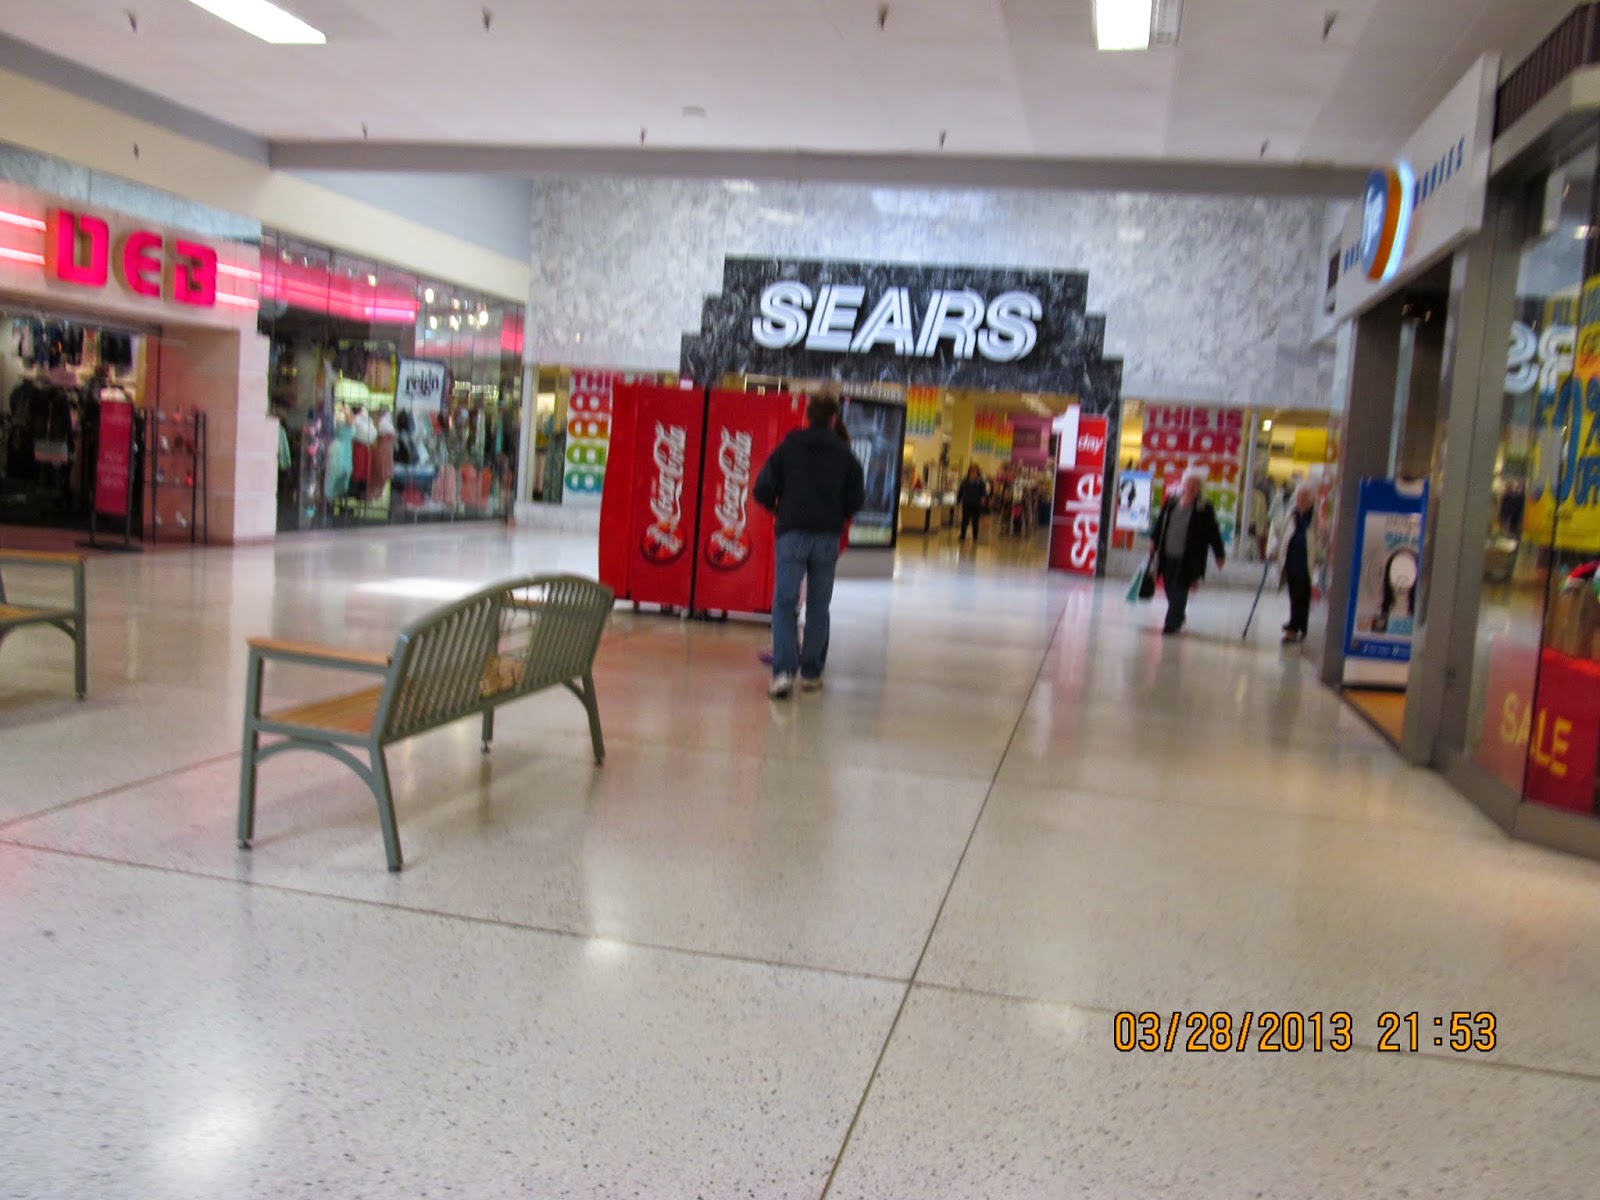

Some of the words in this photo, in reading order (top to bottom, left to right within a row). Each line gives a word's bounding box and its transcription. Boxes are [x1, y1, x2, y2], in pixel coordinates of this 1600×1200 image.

[50, 208, 217, 307] DEB
[752, 280, 1043, 362] SEARS
[650, 419, 687, 524] Coca-Cola
[714, 425, 752, 532] Coca-Cola
[1052, 404, 1081, 468] 1
[1078, 433, 1104, 455] day
[1065, 473, 1102, 569] sale
[1500, 691, 1573, 778] SALE
